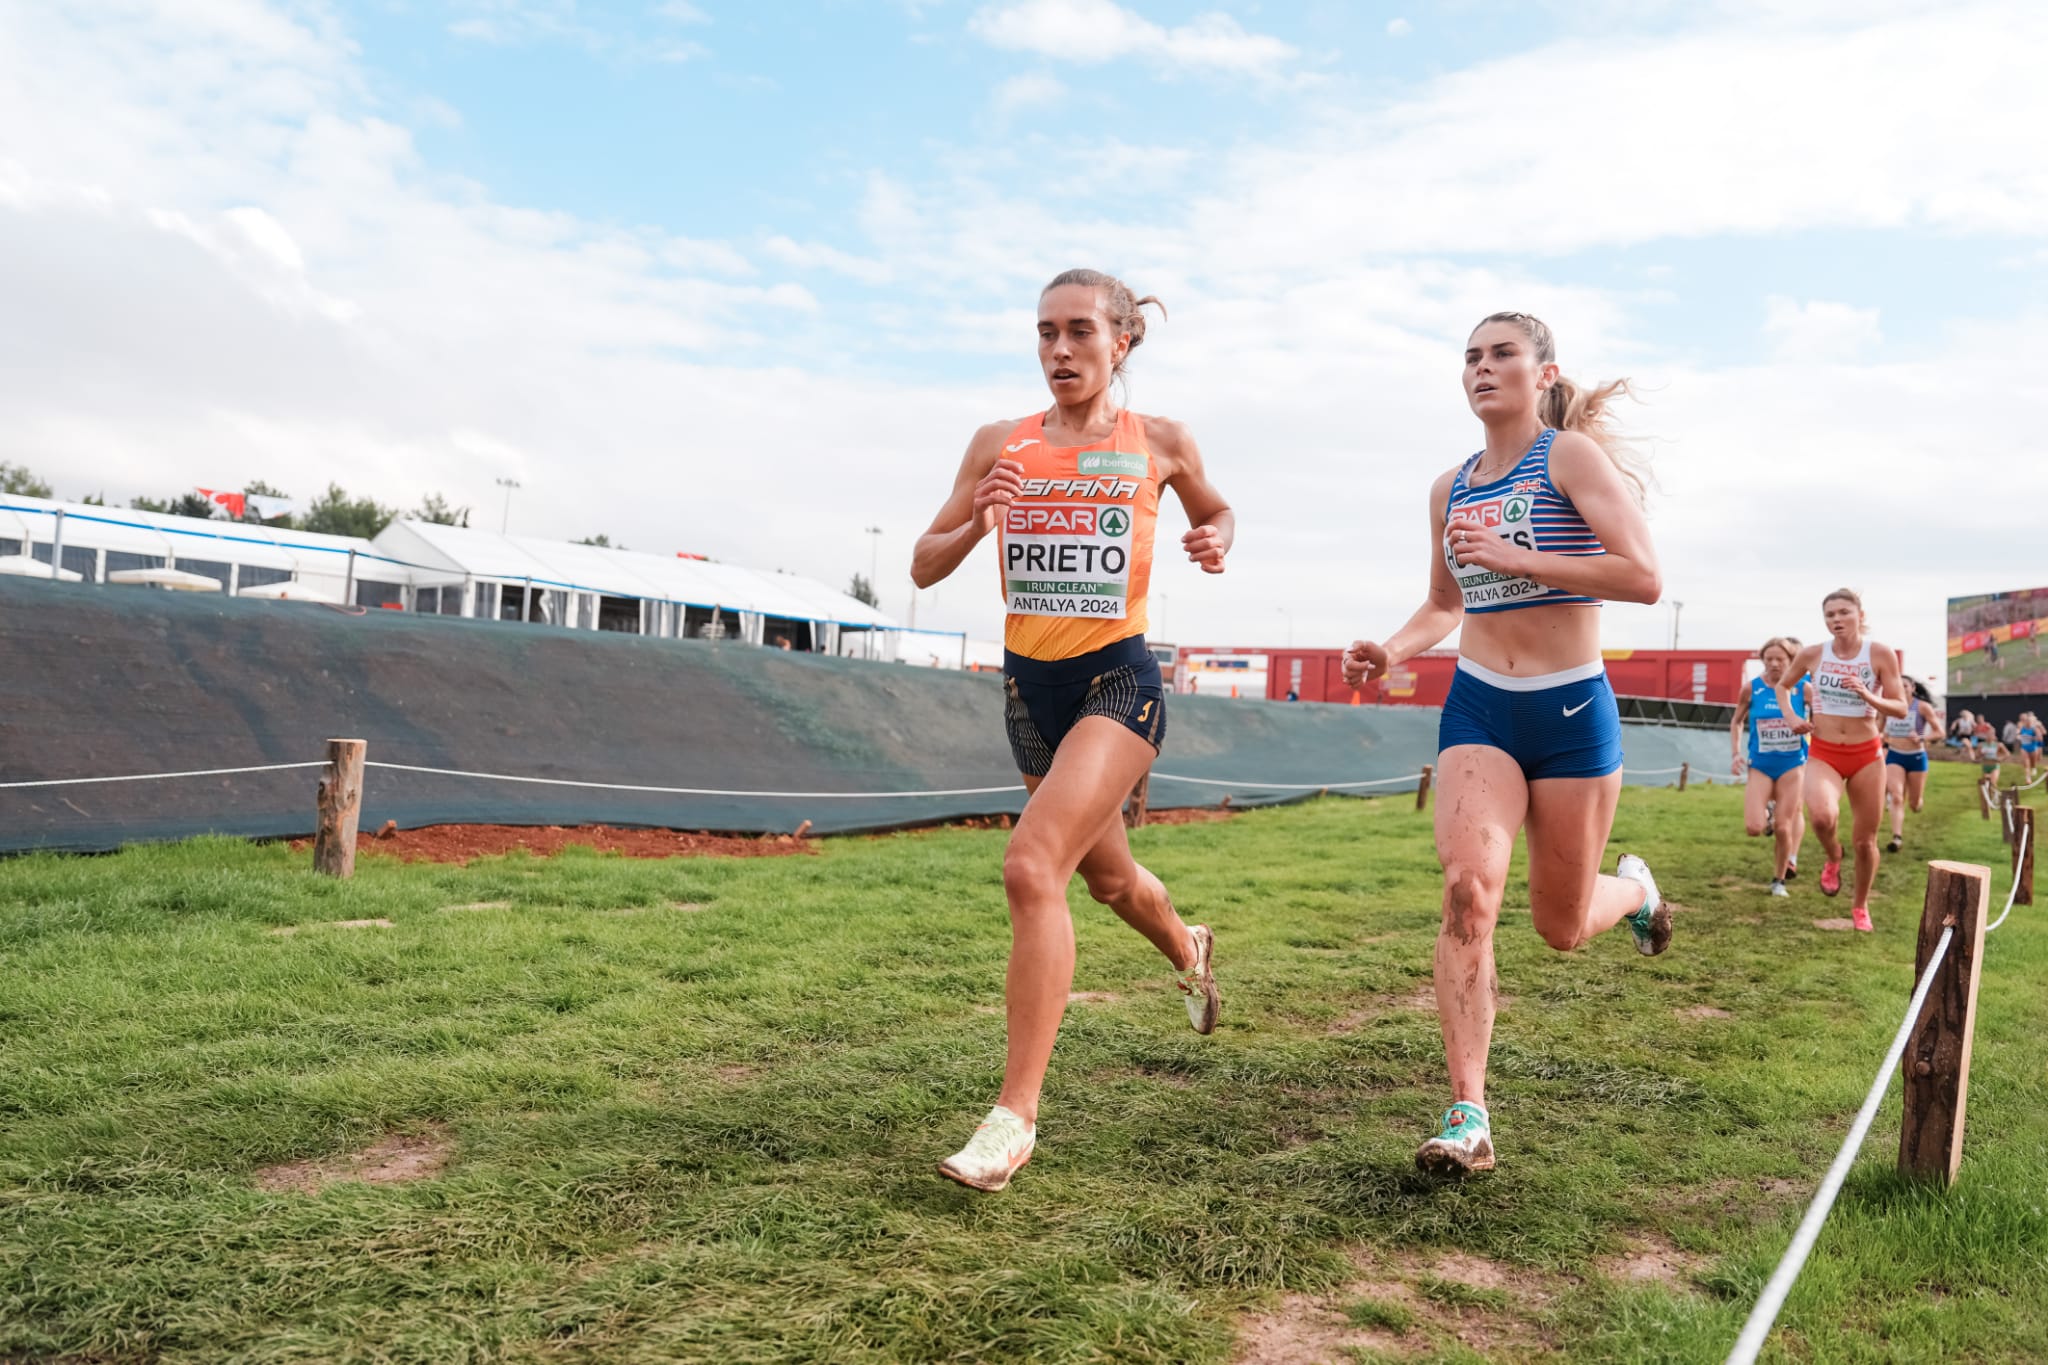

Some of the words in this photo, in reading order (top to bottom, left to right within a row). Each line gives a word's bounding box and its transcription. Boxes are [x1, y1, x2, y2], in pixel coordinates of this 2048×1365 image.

[1020, 476, 1139, 499] SPAÑA
[1008, 509, 1094, 531] SPAR
[1008, 543, 1126, 574] PRIETO
[1031, 582, 1055, 592] RUN
[1464, 574, 1482, 586] RUN
[1501, 581, 1539, 598] 2024
[1014, 597, 1076, 612] ANTALYA
[1080, 599, 1118, 614] 2024
